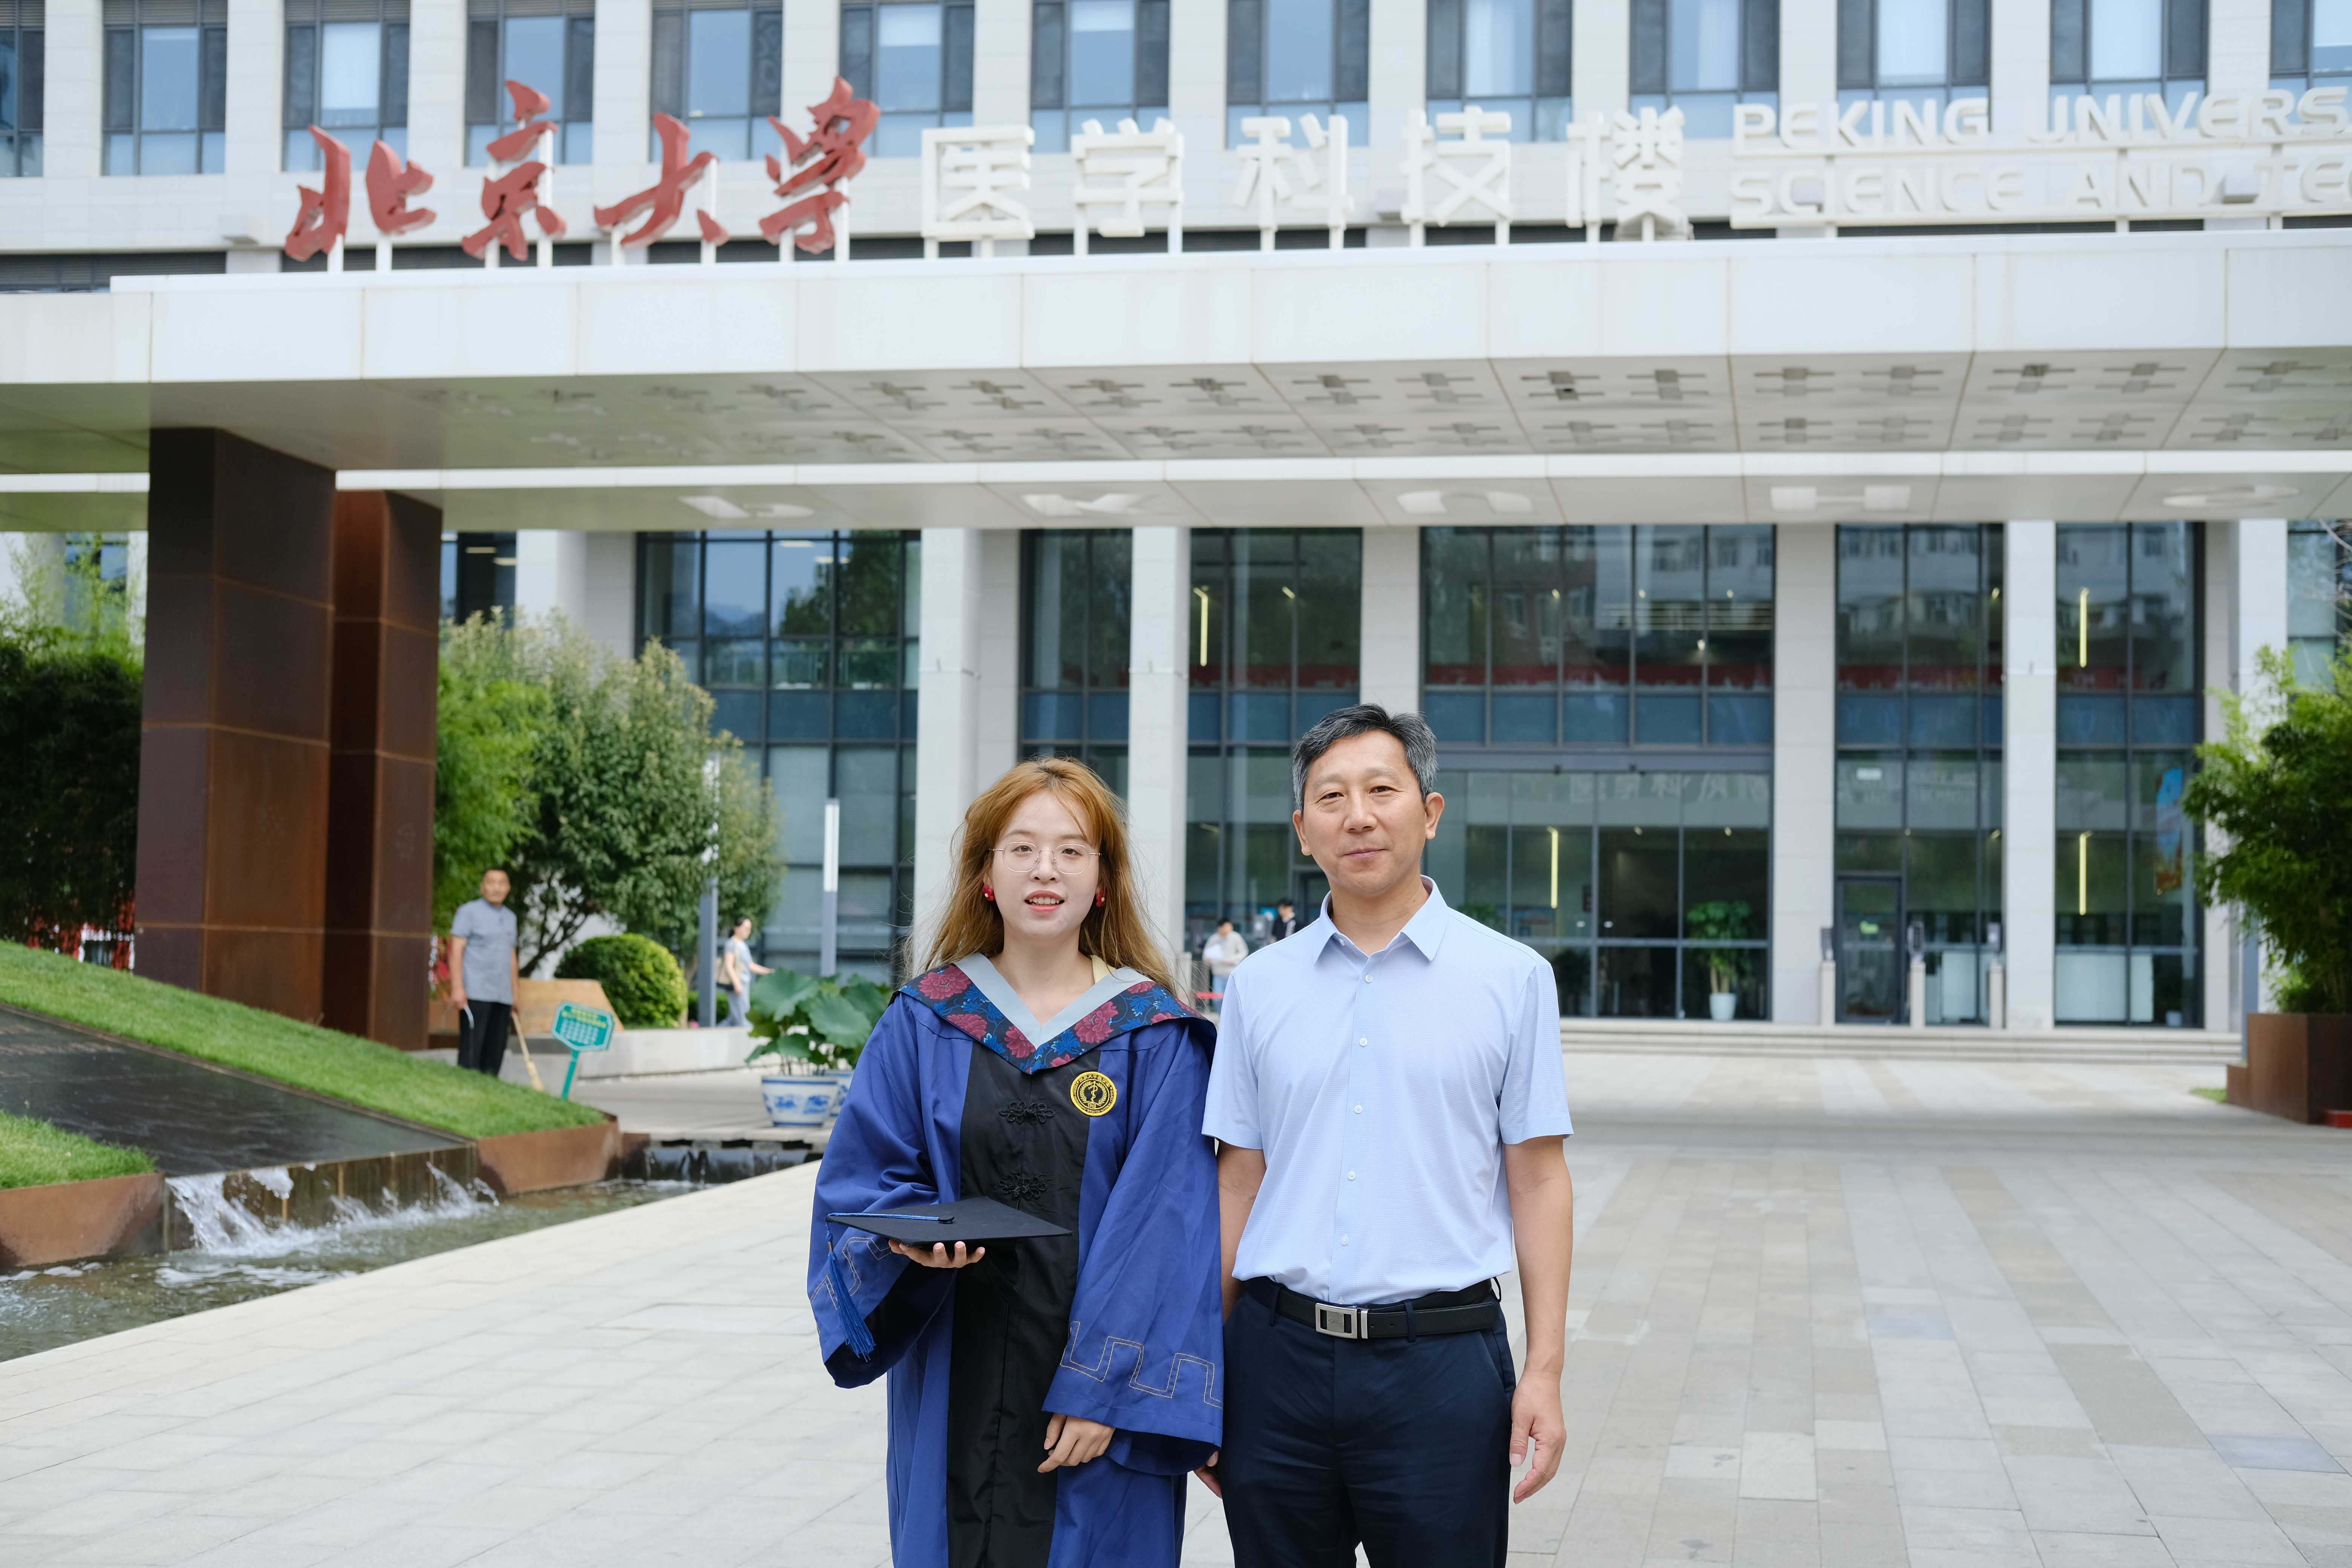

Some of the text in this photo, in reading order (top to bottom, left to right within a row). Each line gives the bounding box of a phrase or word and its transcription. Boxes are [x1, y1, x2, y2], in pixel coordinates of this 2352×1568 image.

[1733, 86, 2350, 152] PEKING UNIVERS
[284, 77, 1688, 260] 北京大学 医学科技楼
[1730, 152, 2352, 219] SCIENCE AND TE
